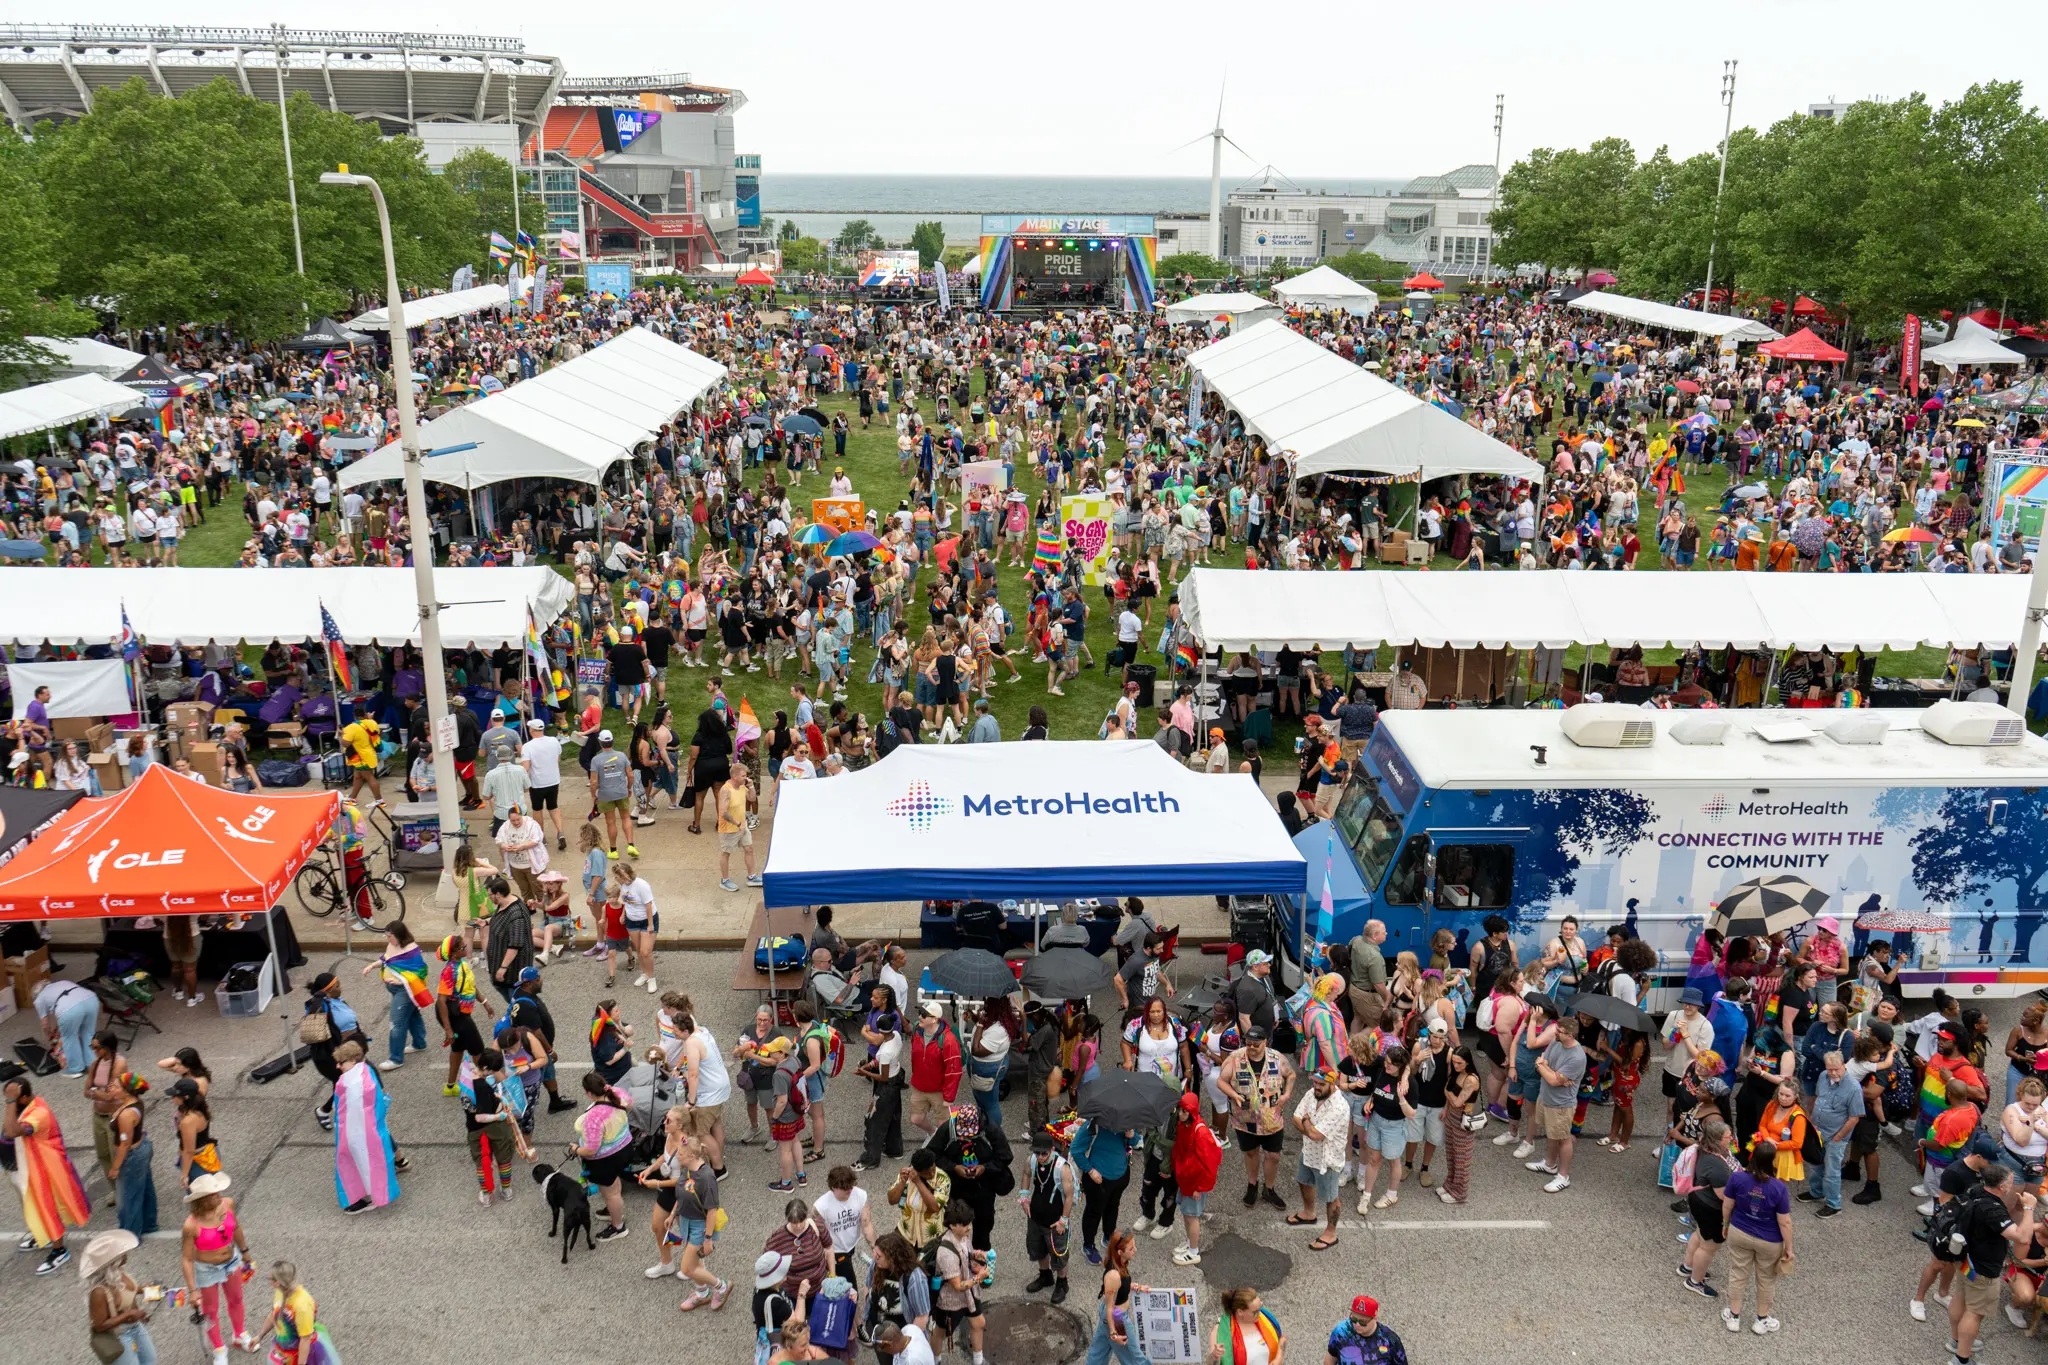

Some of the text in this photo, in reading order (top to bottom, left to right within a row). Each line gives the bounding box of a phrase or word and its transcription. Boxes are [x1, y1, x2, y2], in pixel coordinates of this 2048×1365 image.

[617, 113, 635, 136] Bally
[1027, 218, 1110, 230] MAIN STAGE
[875, 257, 910, 267] PRIDE
[1044, 255, 1082, 265] PRIDE
[607, 278, 622, 286] CLE
[1906, 345, 1914, 376] ARTISAN
[1066, 520, 1108, 538] SO GAY
[1086, 537, 1105, 548] EACH
[579, 665, 605, 676] PRIDE
[963, 790, 1181, 817] MetroHealth
[1738, 801, 1849, 816] MetroHealth
[242, 805, 277, 832] CLE
[1657, 831, 1884, 847] CONNECTING WITH THE
[113, 849, 186, 869] CLE
[1706, 853, 1830, 869] COMMUNITY
[0, 903, 15, 911] LE
[50, 901, 75, 909] CLE
[170, 897, 195, 905] CLE
[231, 895, 255, 903] CLE
[1394, 929, 1400, 937] 4
[1356, 1300, 1367, 1312] A
[1136, 1312, 1145, 1341] DONATIONS
